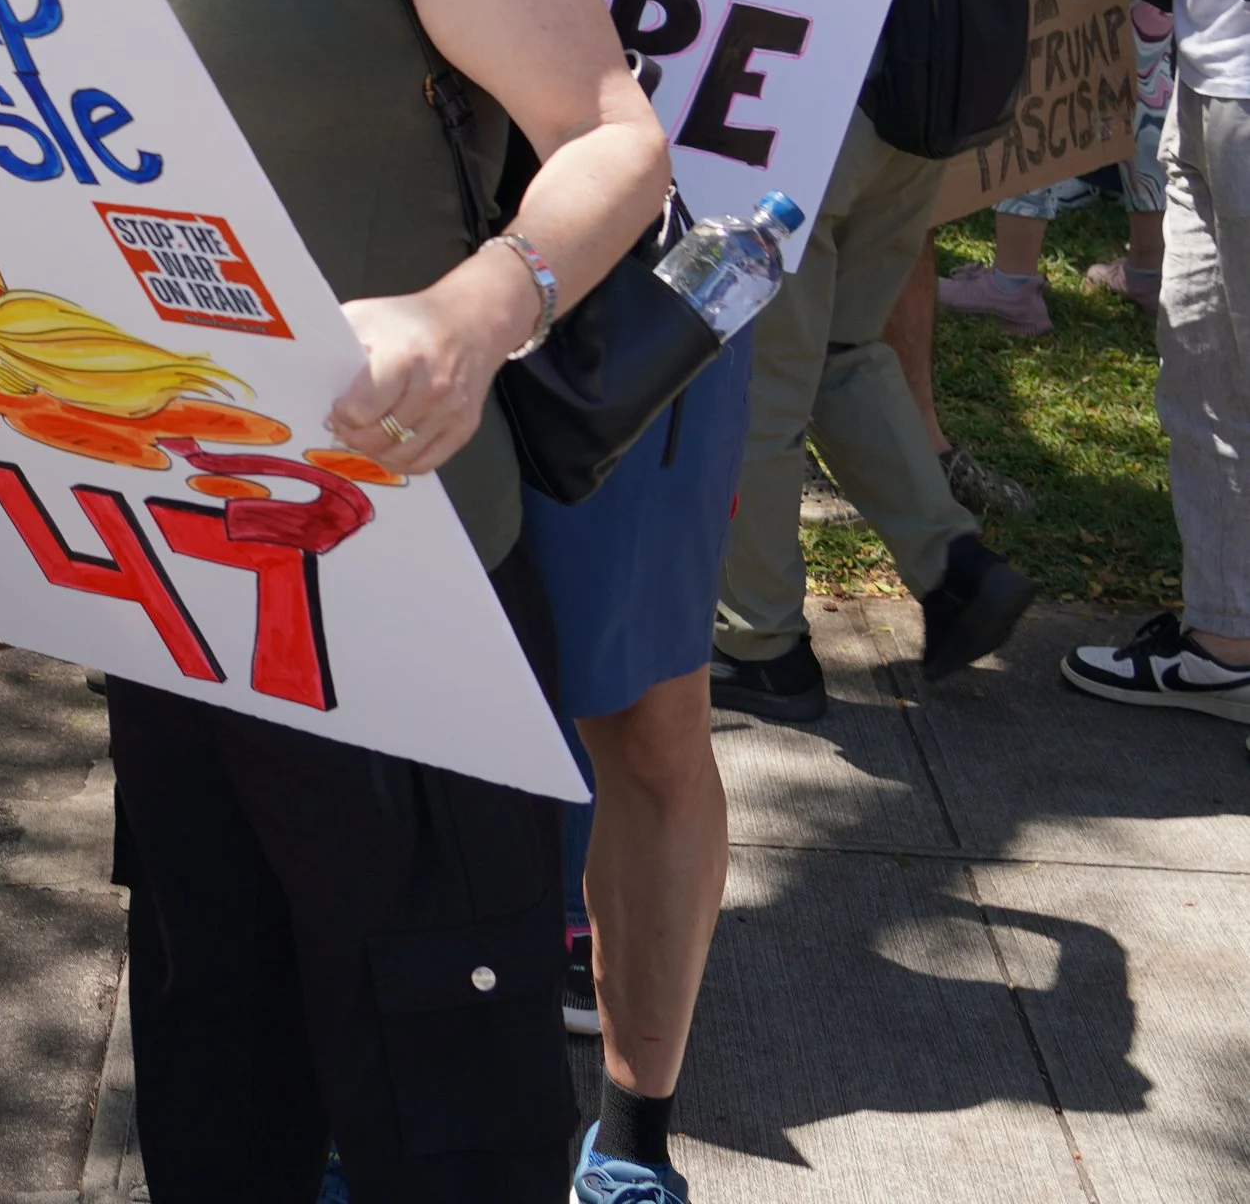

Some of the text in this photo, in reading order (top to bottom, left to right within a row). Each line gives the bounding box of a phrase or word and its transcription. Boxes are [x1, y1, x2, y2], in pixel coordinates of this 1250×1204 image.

[112, 216, 229, 256] STOP THE
[152, 249, 221, 283] WAR
[149, 276, 263, 317] ON IRAN!
